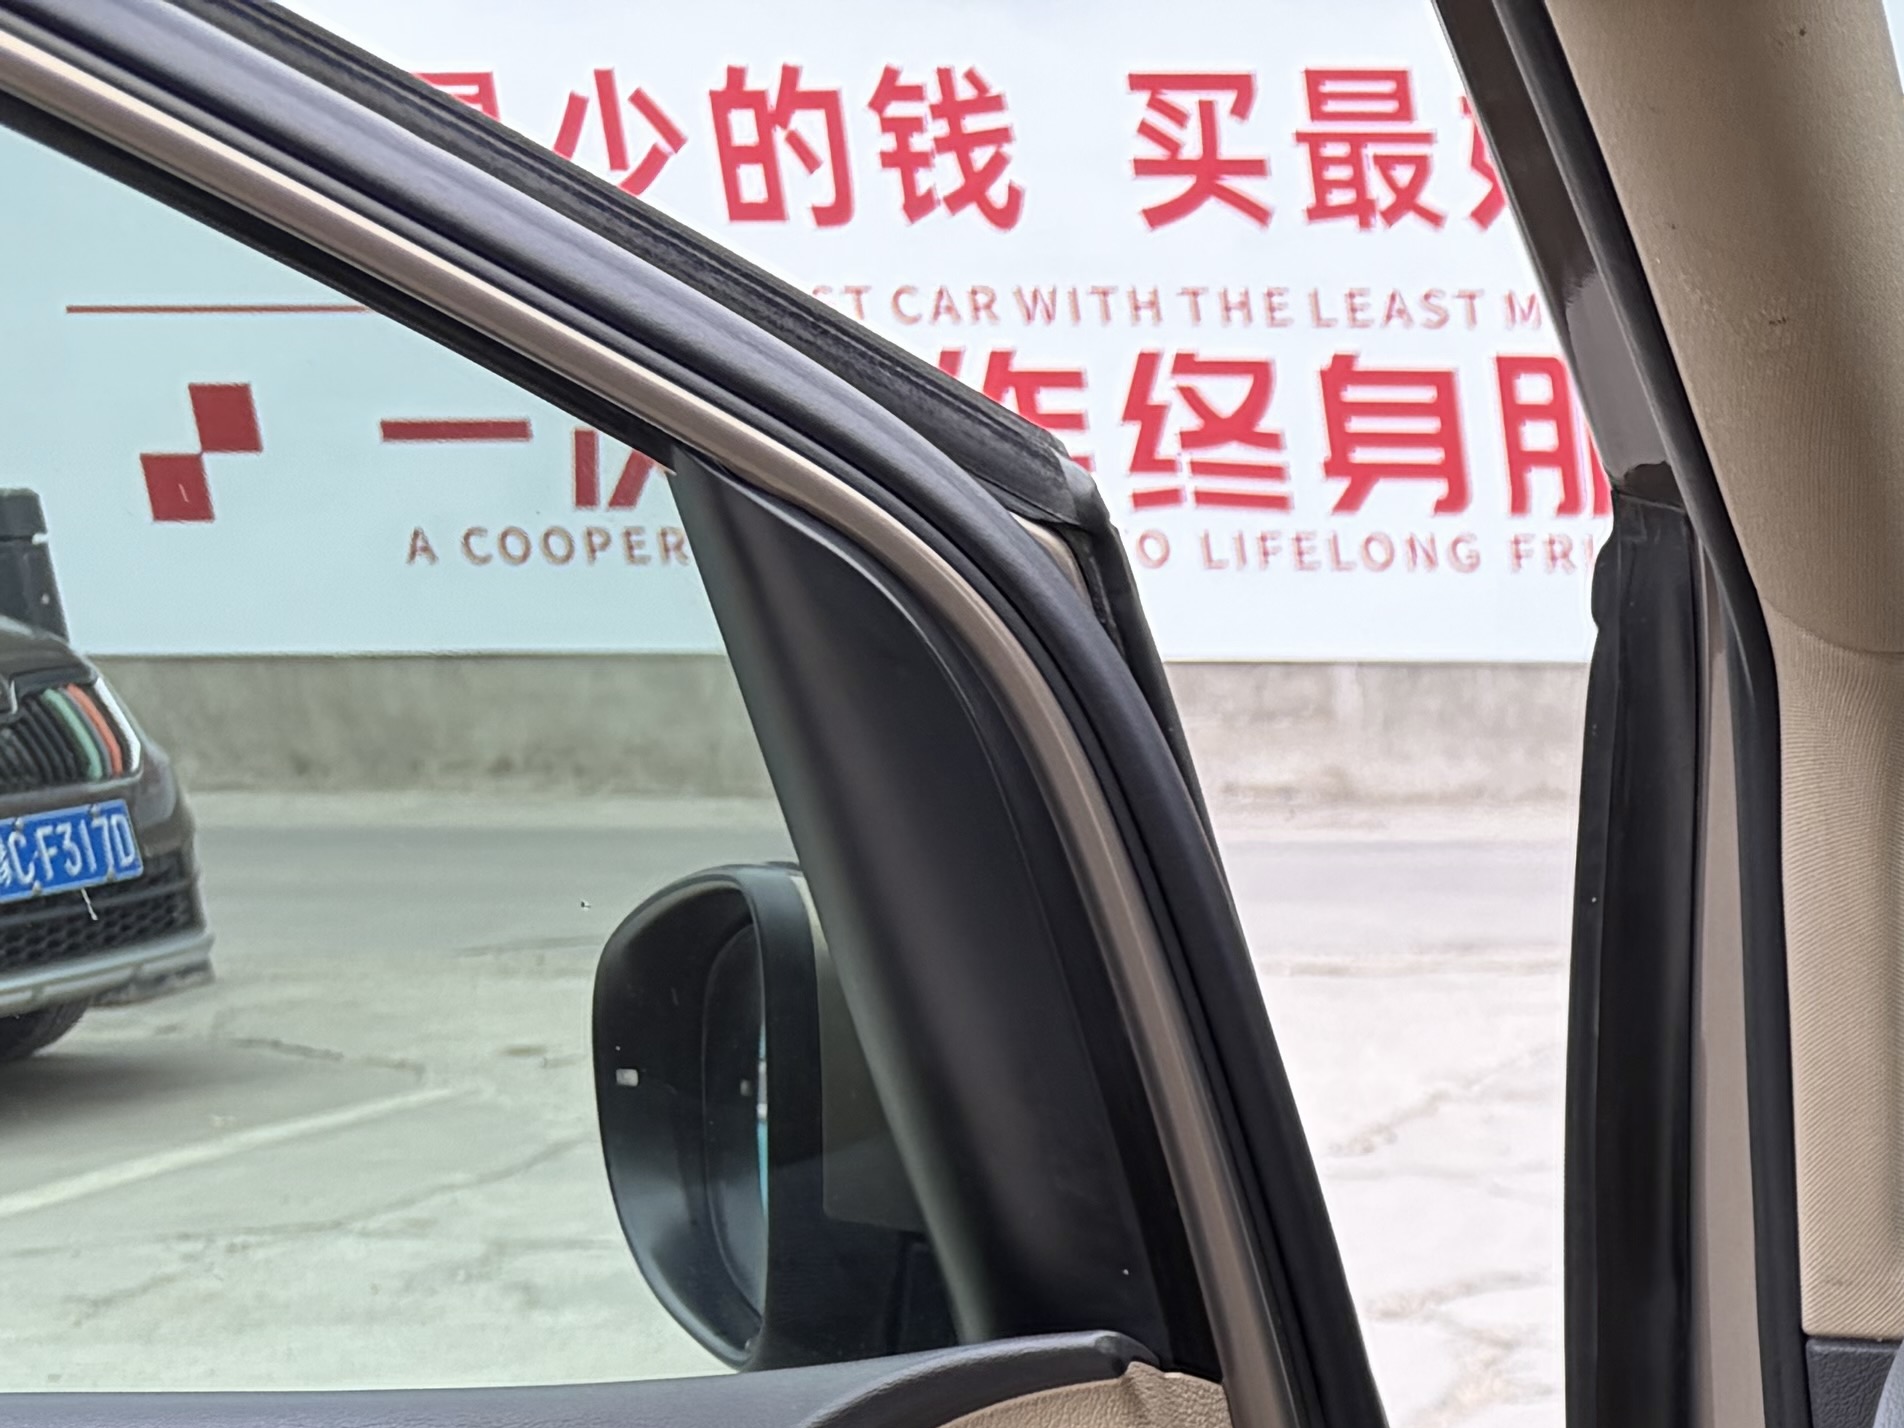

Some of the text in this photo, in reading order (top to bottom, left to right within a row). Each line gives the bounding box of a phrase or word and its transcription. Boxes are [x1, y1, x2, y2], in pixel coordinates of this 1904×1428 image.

[1127, 68, 1506, 231] 买最
[891, 285, 999, 326] CAR
[1012, 285, 1163, 327] WITH
[1180, 286, 1294, 329] THE
[1309, 287, 1485, 331] LEAST
[407, 526, 439, 565] A
[1200, 530, 1482, 573] LIFELONG
